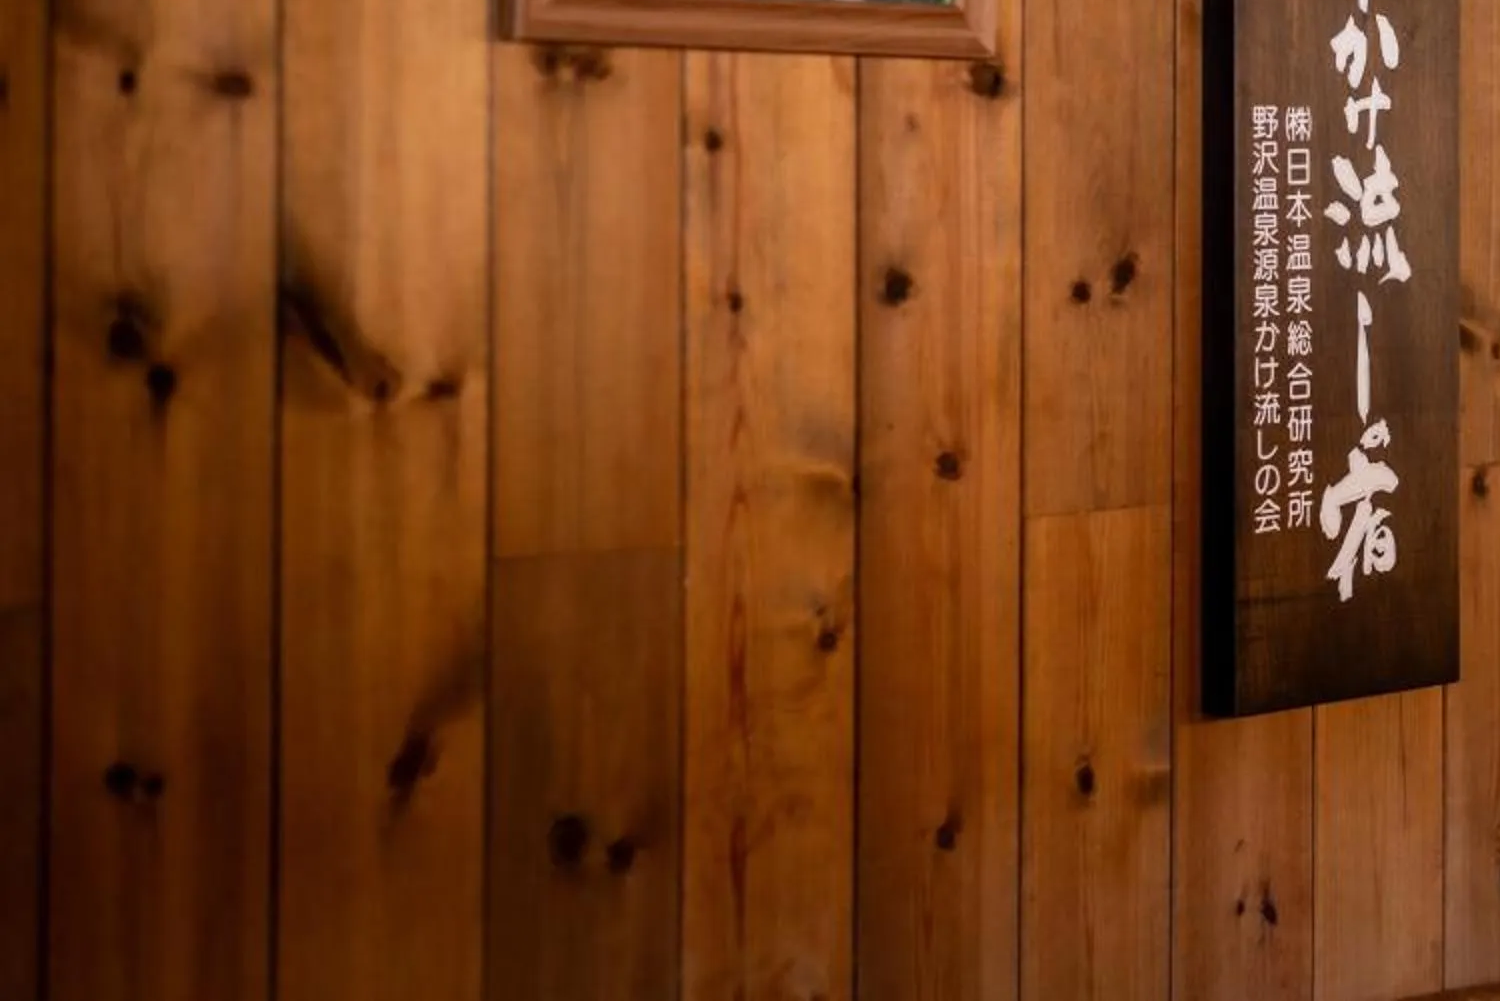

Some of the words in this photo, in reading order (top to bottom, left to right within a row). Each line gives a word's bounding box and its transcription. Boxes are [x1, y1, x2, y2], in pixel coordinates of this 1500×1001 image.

[1251, 104, 1281, 534] 野沢温泉源泉かけ流しの会
